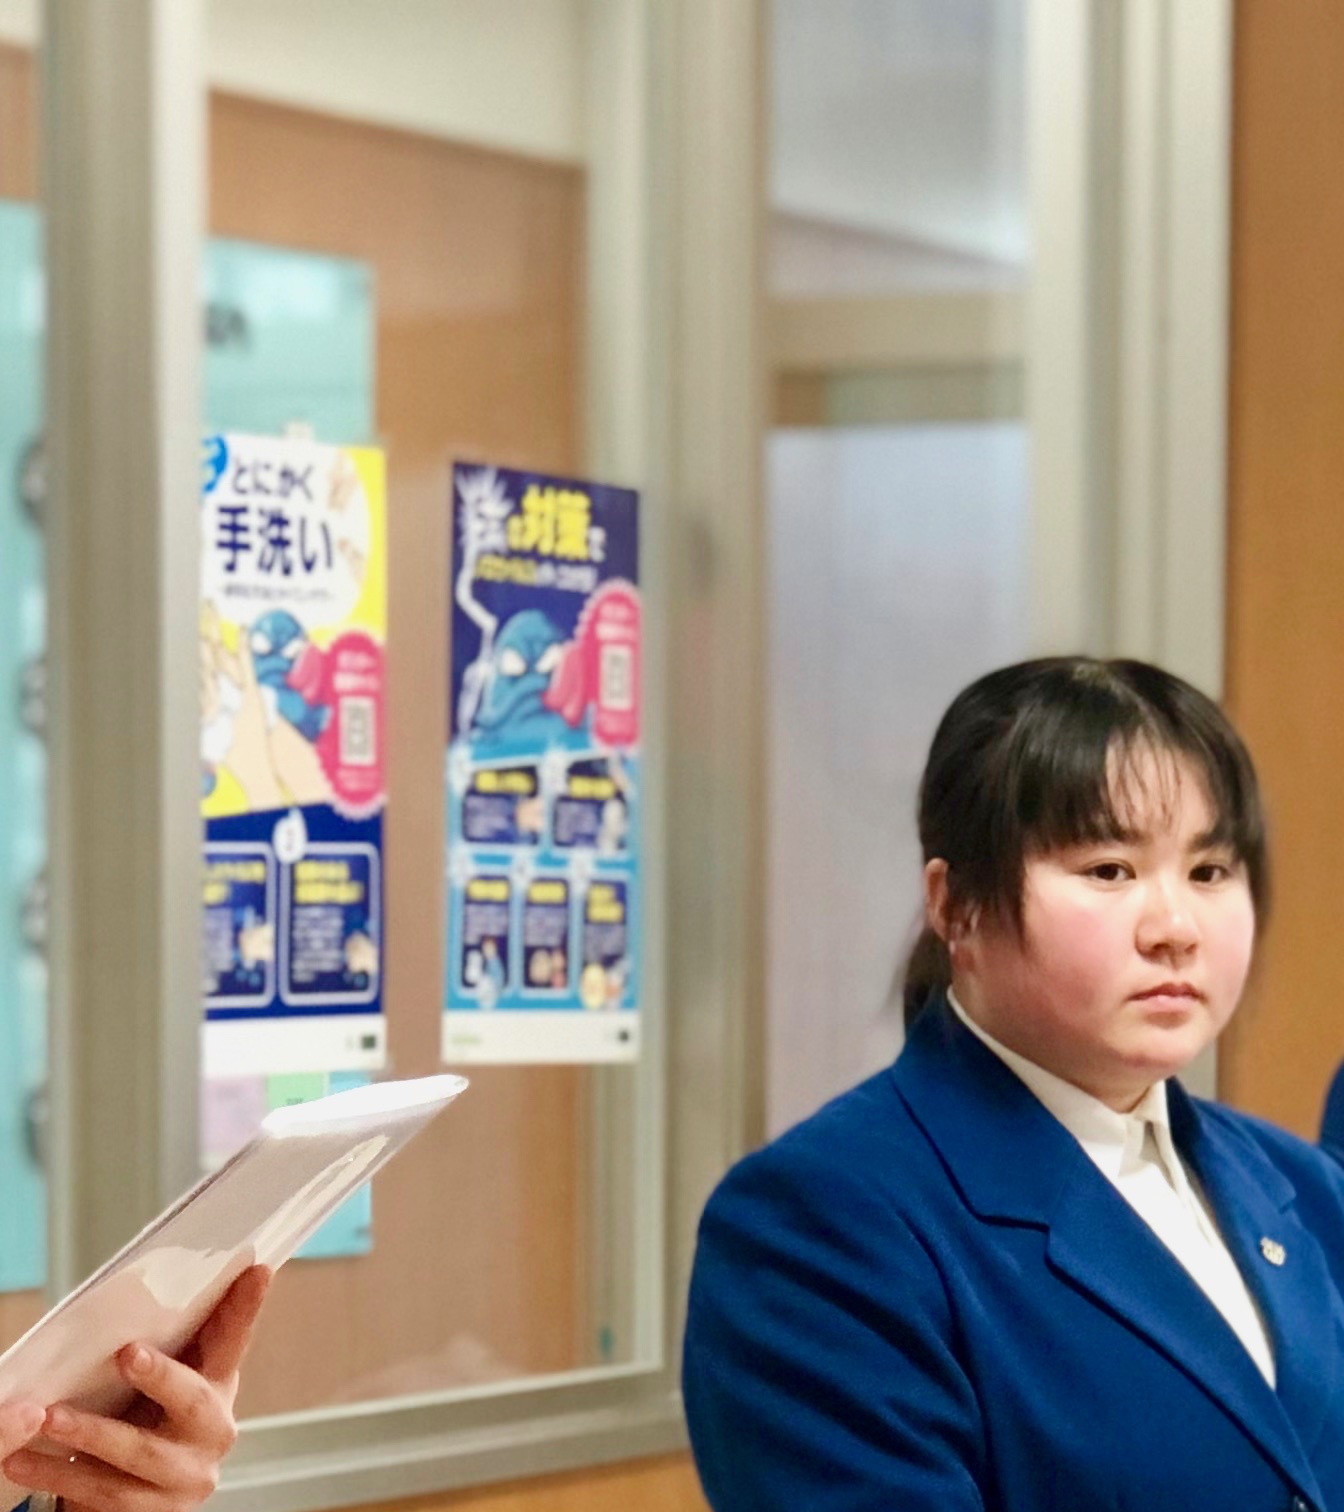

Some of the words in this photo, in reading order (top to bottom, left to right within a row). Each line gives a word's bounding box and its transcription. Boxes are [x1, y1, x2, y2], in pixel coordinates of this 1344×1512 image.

[232, 457, 314, 502] とにかく
[216, 505, 333, 577] 手洗い
